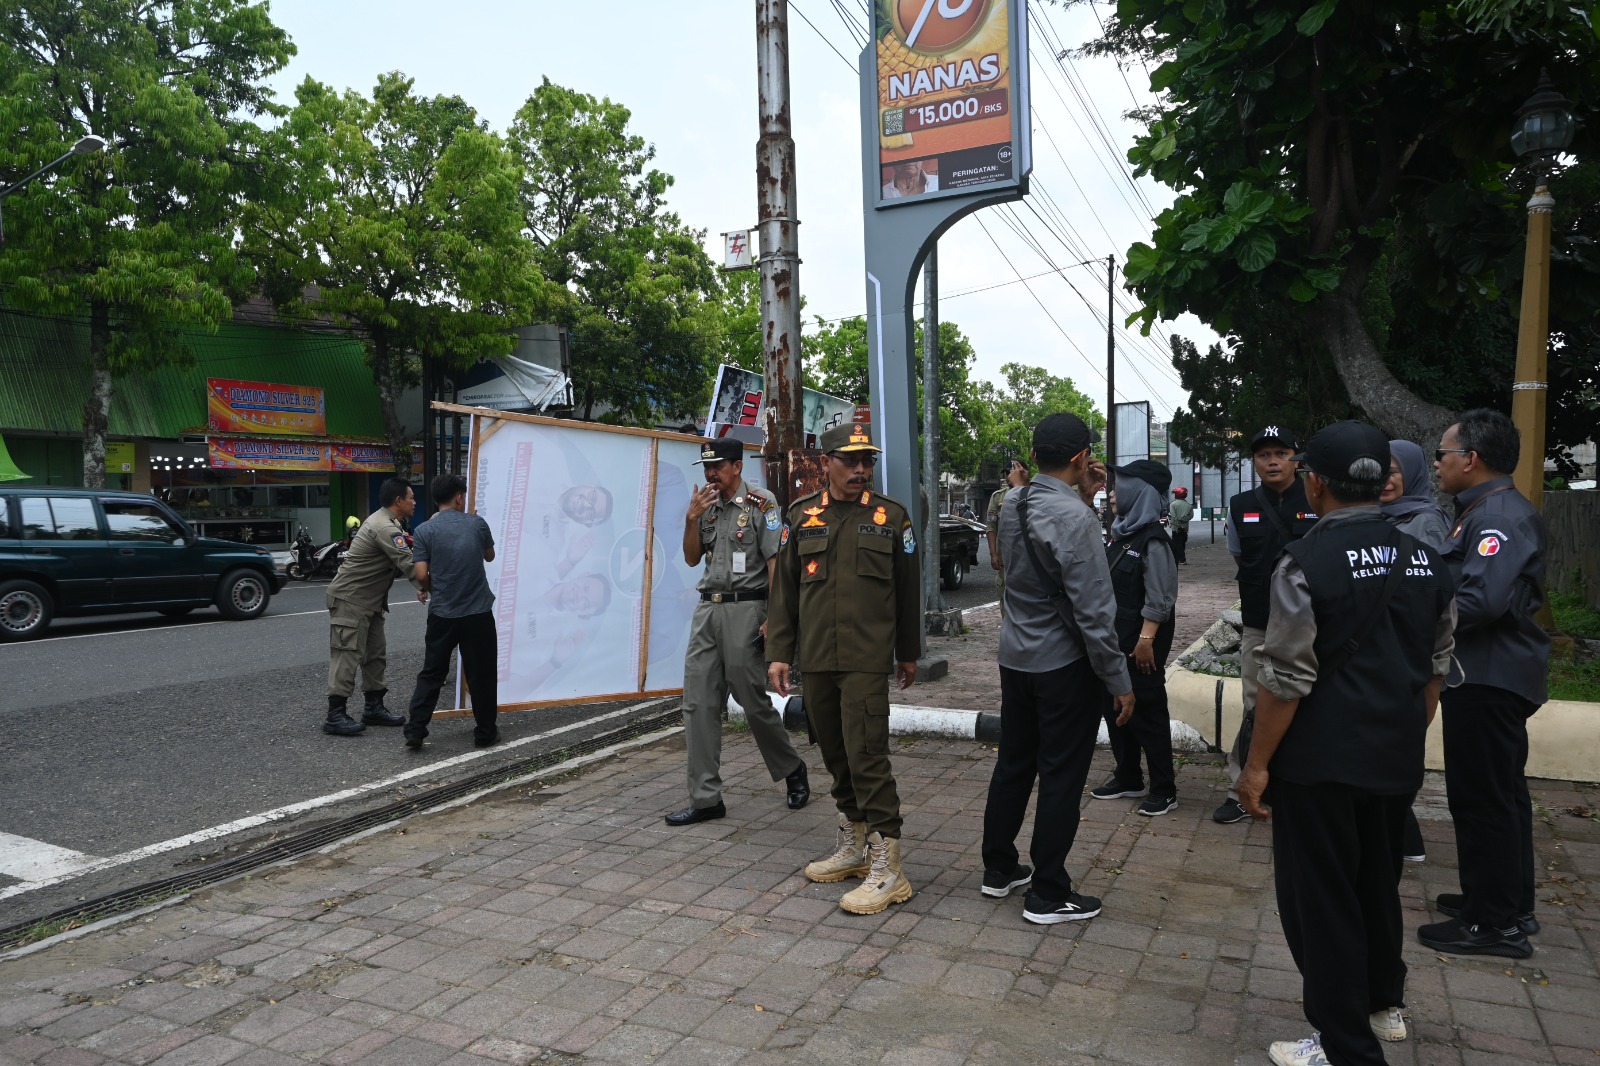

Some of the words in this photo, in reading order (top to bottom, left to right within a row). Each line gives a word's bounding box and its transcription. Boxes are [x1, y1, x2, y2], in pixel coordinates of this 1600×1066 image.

[889, 54, 1000, 100] NANAS
[917, 97, 979, 126] 15.000
[952, 165, 999, 178] PERINGATAN:
[229, 387, 271, 404] DIAMOND
[272, 390, 301, 406] SILVER
[302, 394, 316, 407] 925
[233, 441, 274, 455] DIAMOND
[275, 443, 305, 456] SILVER
[306, 446, 320, 456] 925
[351, 447, 385, 459] DIAMOND
[859, 525, 878, 534] POL
[880, 528, 892, 537] PP
